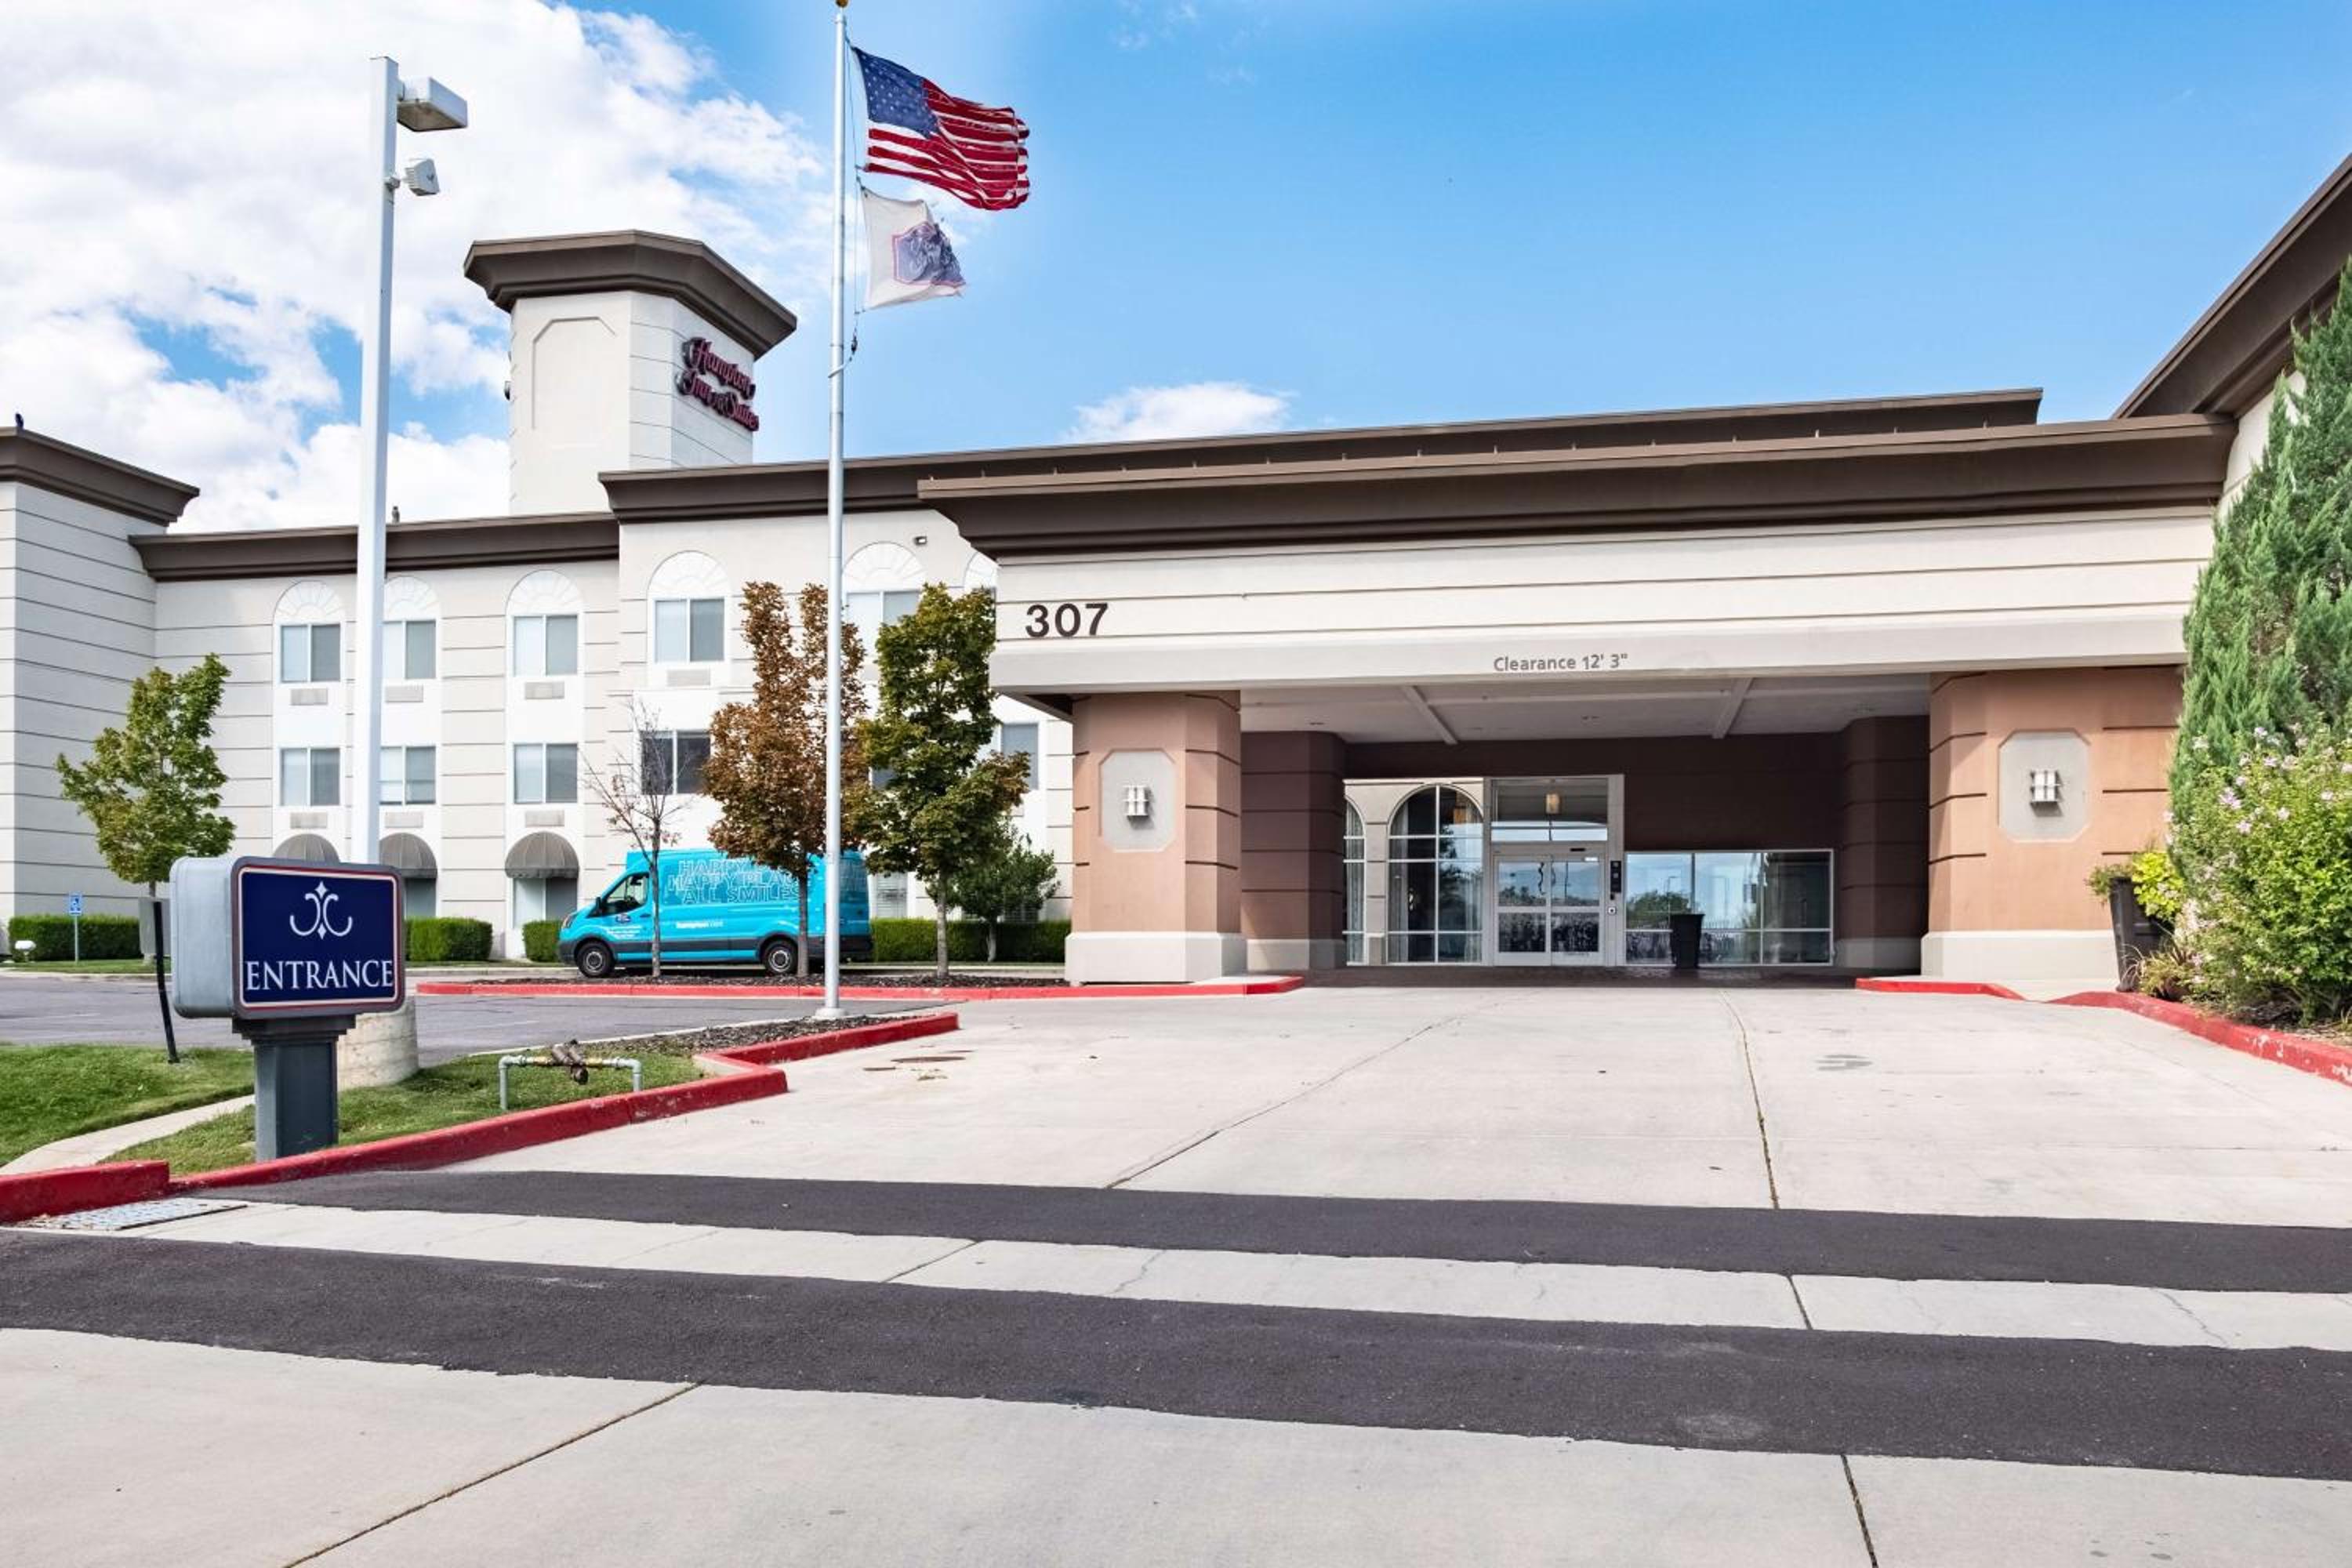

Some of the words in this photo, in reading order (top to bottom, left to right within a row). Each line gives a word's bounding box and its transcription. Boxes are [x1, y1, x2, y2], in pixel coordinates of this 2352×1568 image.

[1025, 602, 1109, 638] 307
[1493, 656, 1577, 672] Clearance
[1581, 654, 1605, 670] 12'
[1610, 652, 1628, 669] 3"
[683, 887, 723, 903] ALL
[245, 959, 394, 991] ENTRANCE
